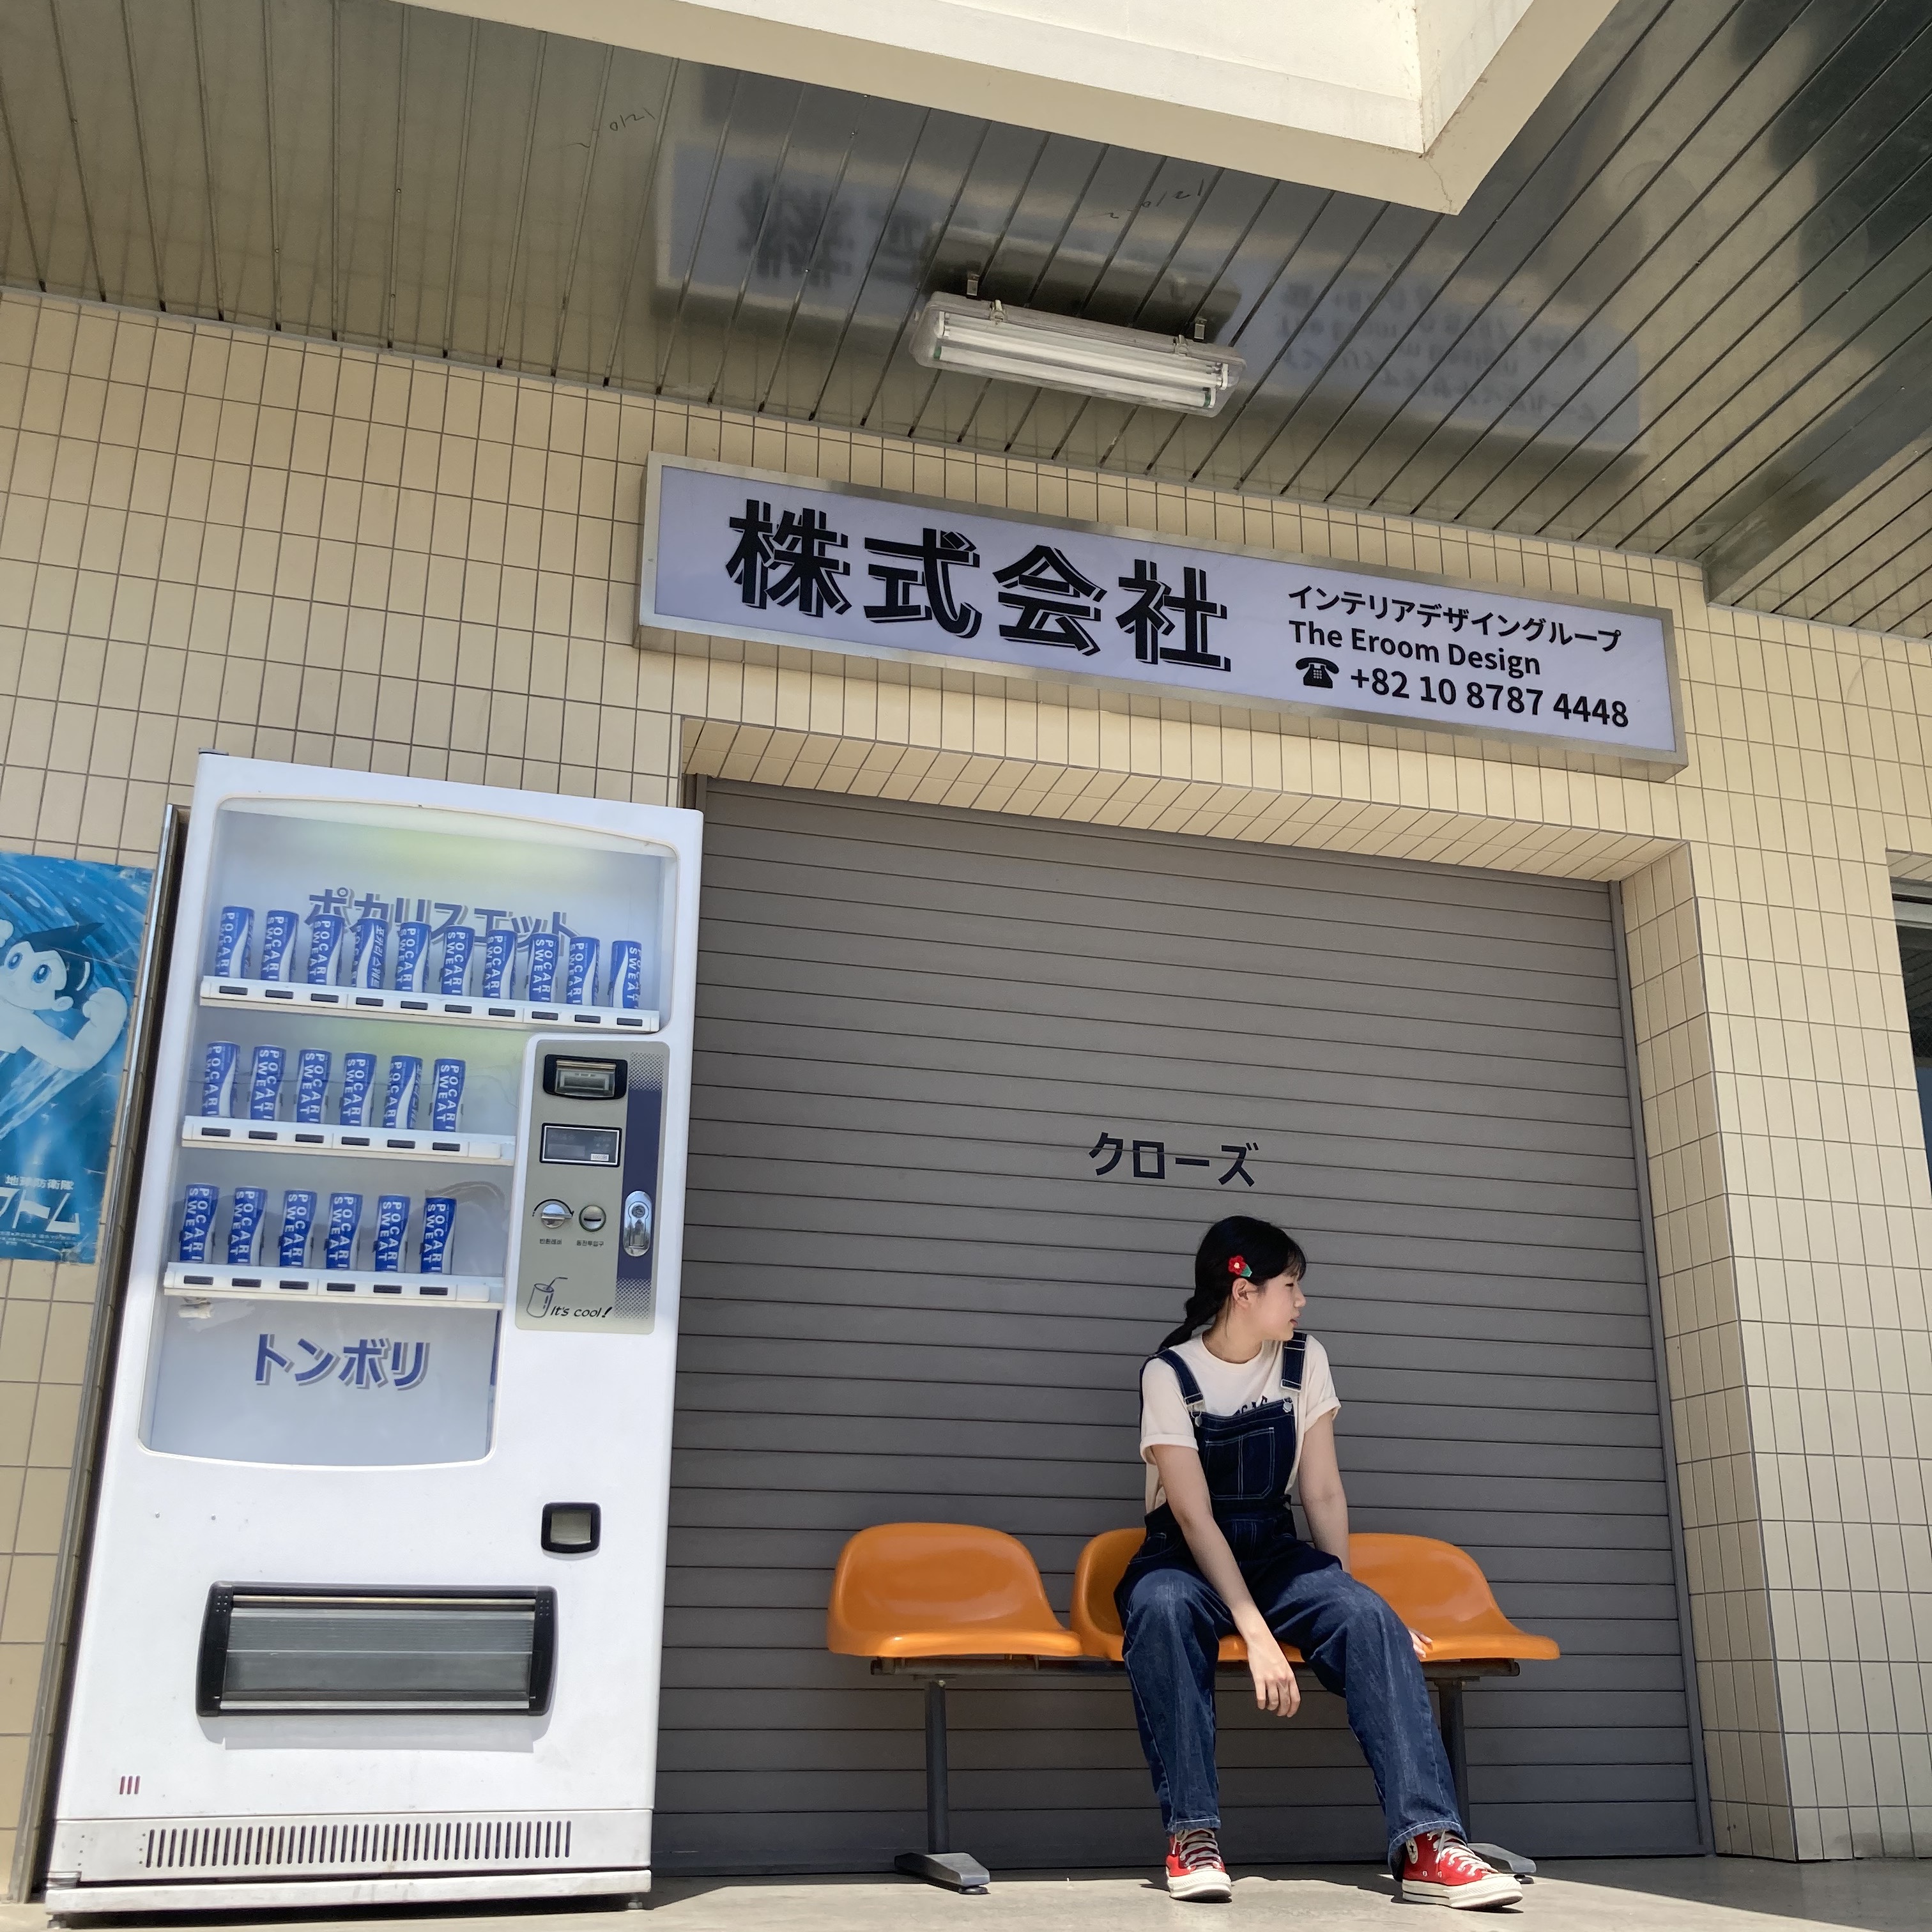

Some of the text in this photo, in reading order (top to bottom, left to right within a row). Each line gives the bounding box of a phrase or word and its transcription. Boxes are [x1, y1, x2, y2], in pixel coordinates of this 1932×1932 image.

[725, 498, 1232, 672] 株式会社
[1288, 585, 1622, 652] インテリアデザイングループ
[1288, 619, 1540, 679] The Eroom Design
[1351, 668, 1629, 728] +82 10 8787 4448
[218, 912, 235, 976] POCARI
[268, 916, 284, 979] POCARI
[316, 921, 332, 982] POCARI
[402, 928, 417, 990] POCARI
[443, 931, 456, 986] SWEAT
[451, 931, 466, 993] POCARI
[489, 935, 503, 997] POCARI
[532, 939, 545, 993] SWEAT
[540, 939, 554, 1001] POCARI
[572, 942, 585, 1004] POCARI
[626, 947, 638, 1001] SWEAT
[208, 1045, 222, 1115] POCARI
[254, 1050, 269, 1111] SWEAT
[263, 1050, 280, 1119] POCARI
[300, 1053, 315, 1114] SWEAT
[309, 1053, 325, 1122] POCARI
[342, 1059, 356, 1116] SWEAT
[349, 1059, 365, 1124] POCARI
[386, 1061, 402, 1126] POCARI
[436, 1065, 450, 1122] SWEAT
[445, 1065, 459, 1130] POCARI
[1088, 1132, 1259, 1187] クローズ
[183, 1188, 198, 1252] SWEAT
[192, 1188, 210, 1260] POCARI
[230, 1192, 244, 1255] SWEAT
[238, 1191, 255, 1262] POCARI
[282, 1194, 297, 1257] SWEAT
[291, 1194, 308, 1266] POCARI
[329, 1197, 343, 1260] SWEAT
[338, 1196, 354, 1268] POCARI
[379, 1201, 391, 1261] SWEAT
[387, 1202, 402, 1269] POCARI
[424, 1204, 436, 1262] SWEAT
[431, 1204, 446, 1270] POCARI
[551, 1305, 570, 1317] It's
[255, 1333, 428, 1390] トンボリ
